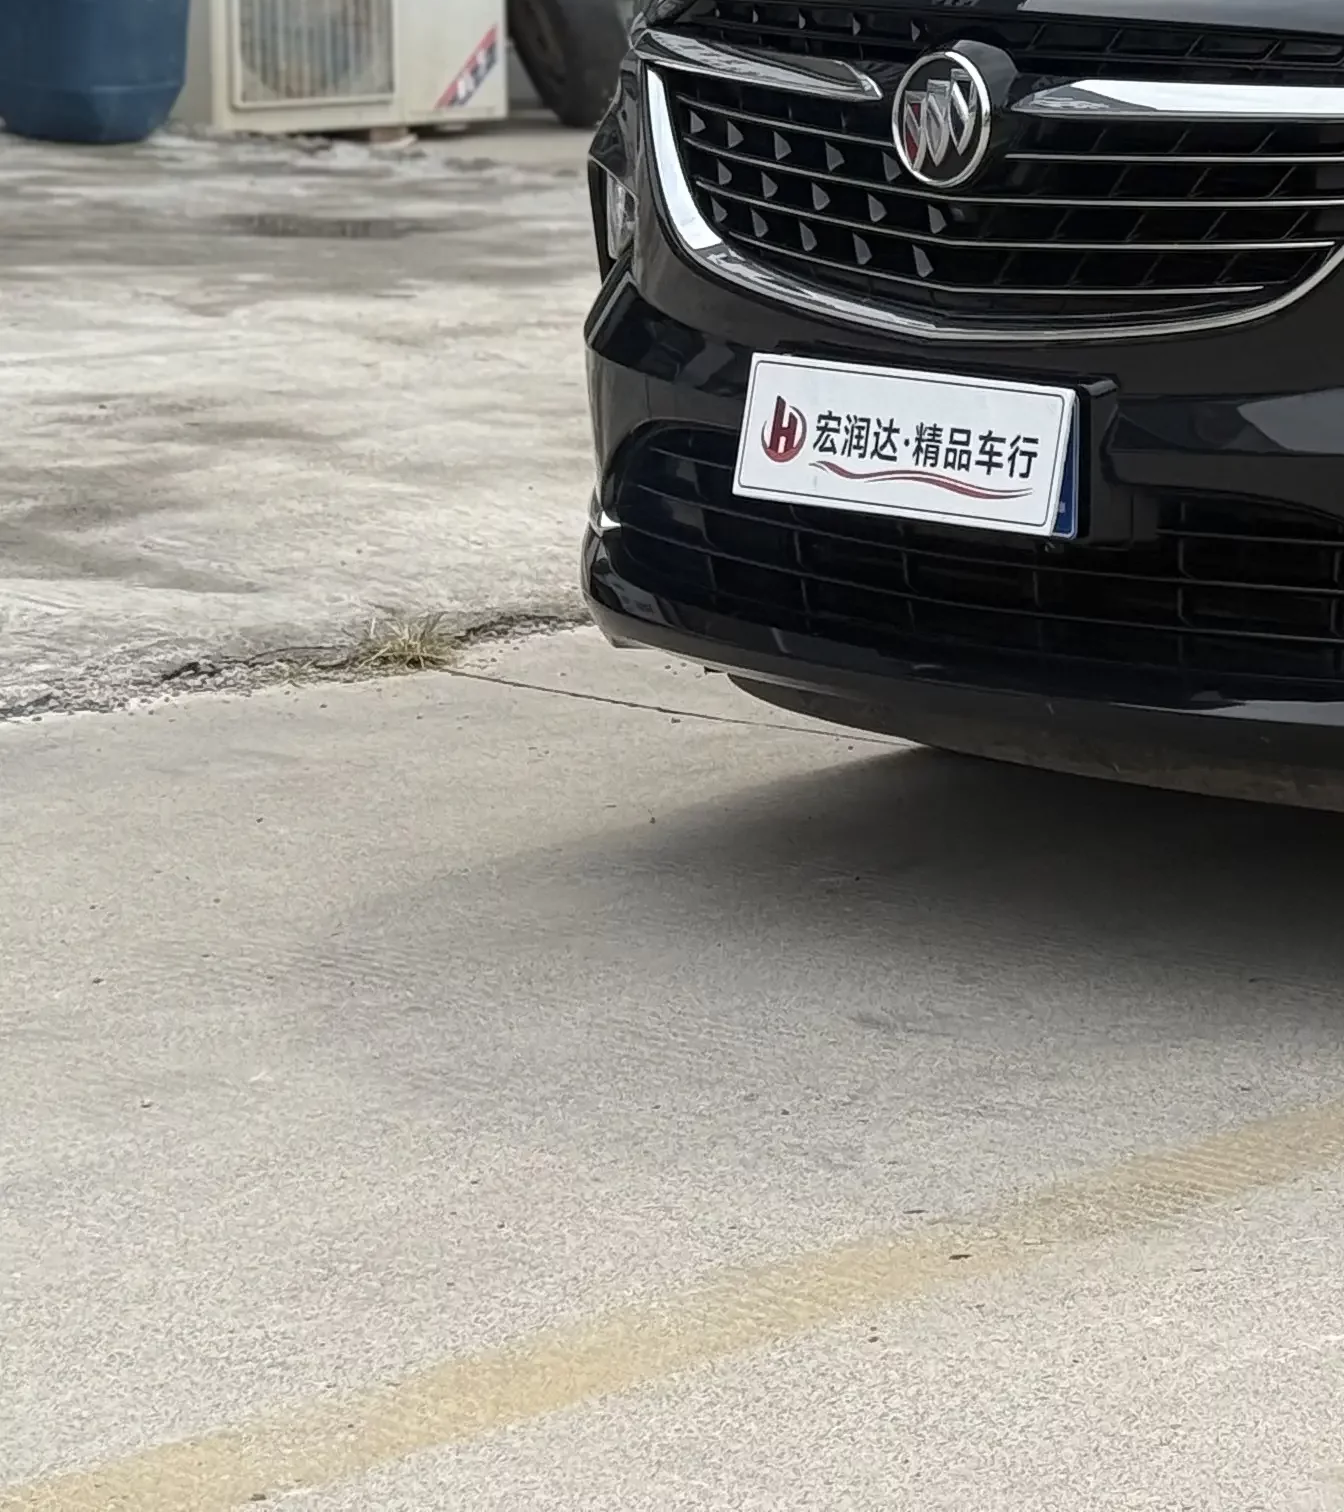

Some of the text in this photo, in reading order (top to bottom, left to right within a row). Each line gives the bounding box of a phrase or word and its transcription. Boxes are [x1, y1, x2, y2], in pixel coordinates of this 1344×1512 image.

[812, 409, 1040, 479] 宏润达·精品车行
